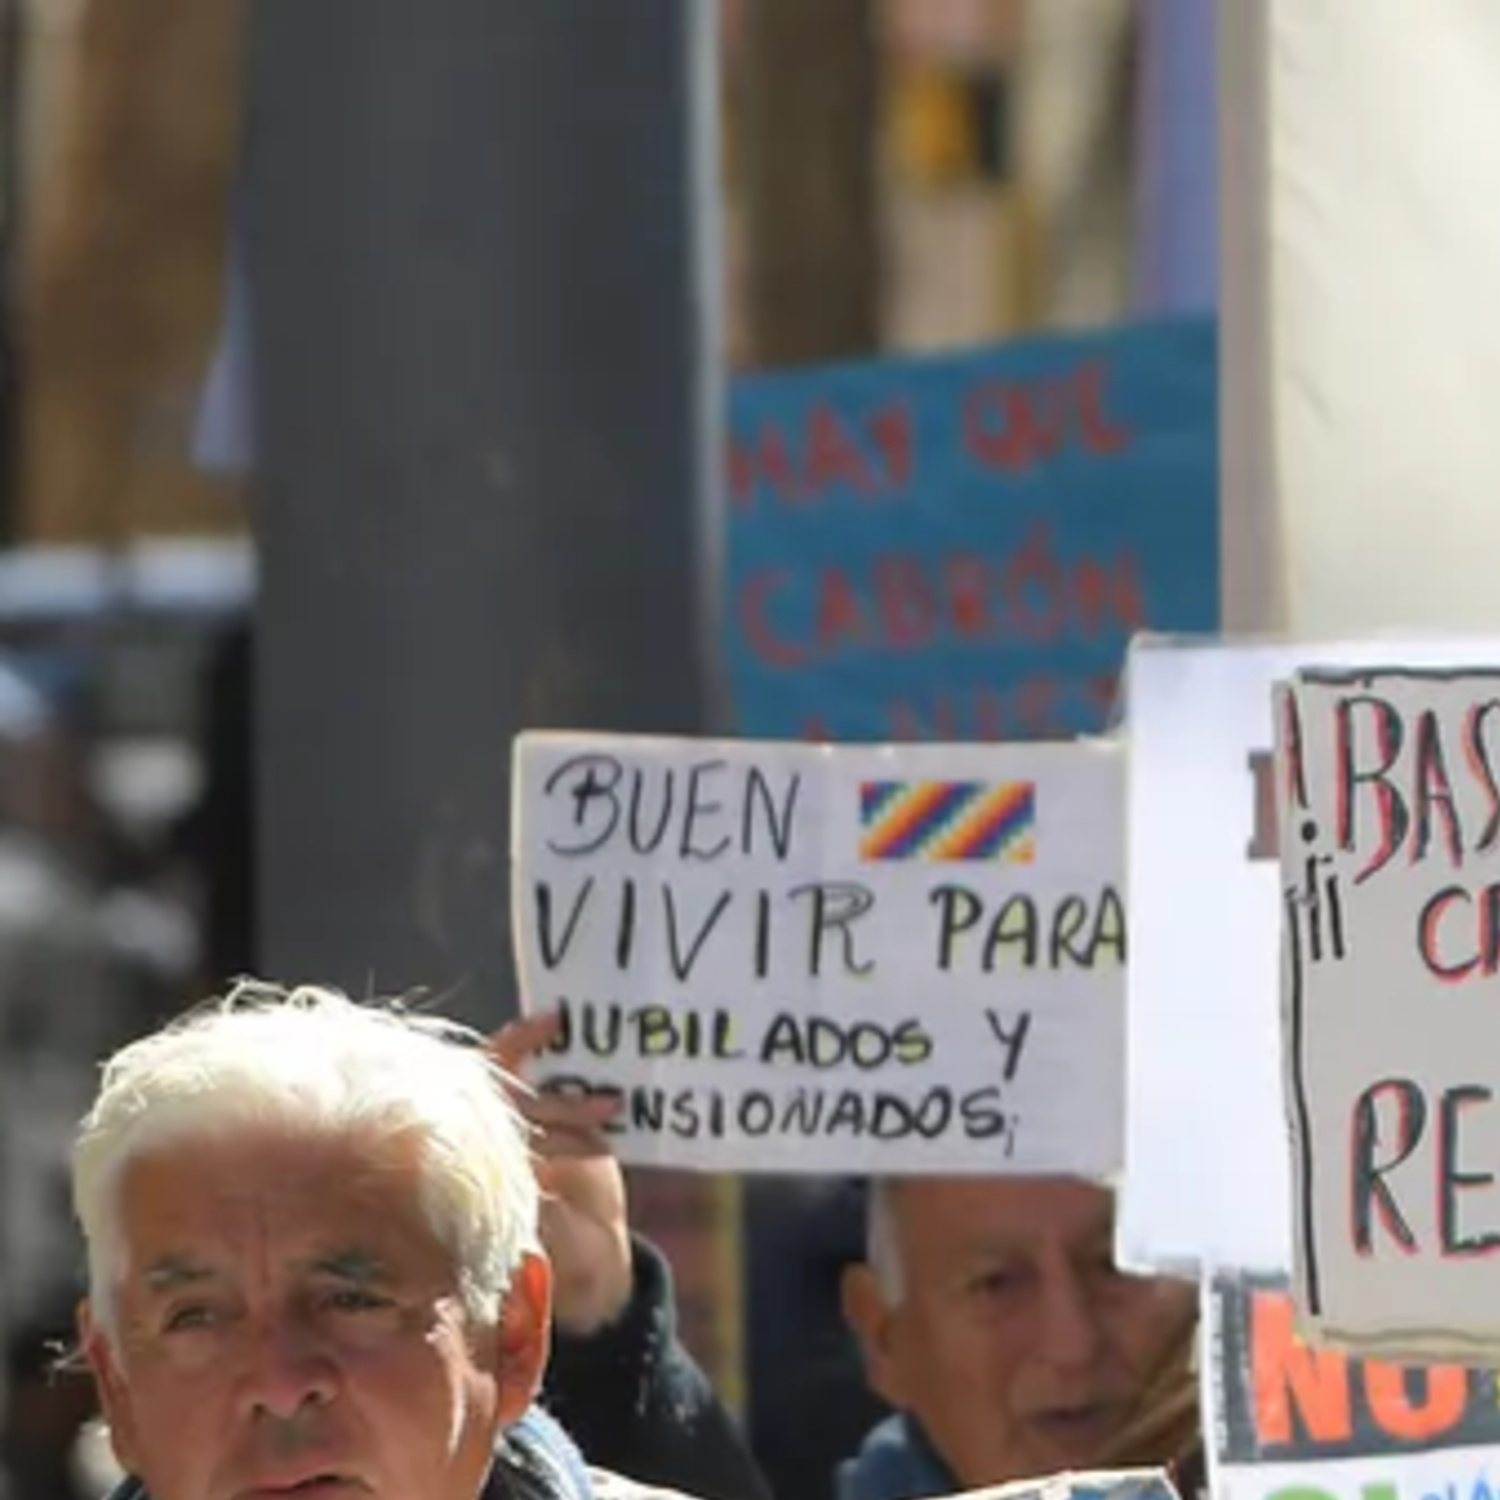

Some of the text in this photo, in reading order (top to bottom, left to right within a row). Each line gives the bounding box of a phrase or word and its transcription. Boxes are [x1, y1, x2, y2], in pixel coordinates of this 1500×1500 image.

[960, 352, 1133, 475] QUE
[544, 753, 800, 860] BUEN
[535, 878, 1127, 982] VIVIR PARA
[535, 997, 1031, 1080] JUBILADOS Y
[1248, 1290, 1468, 1446] NO
